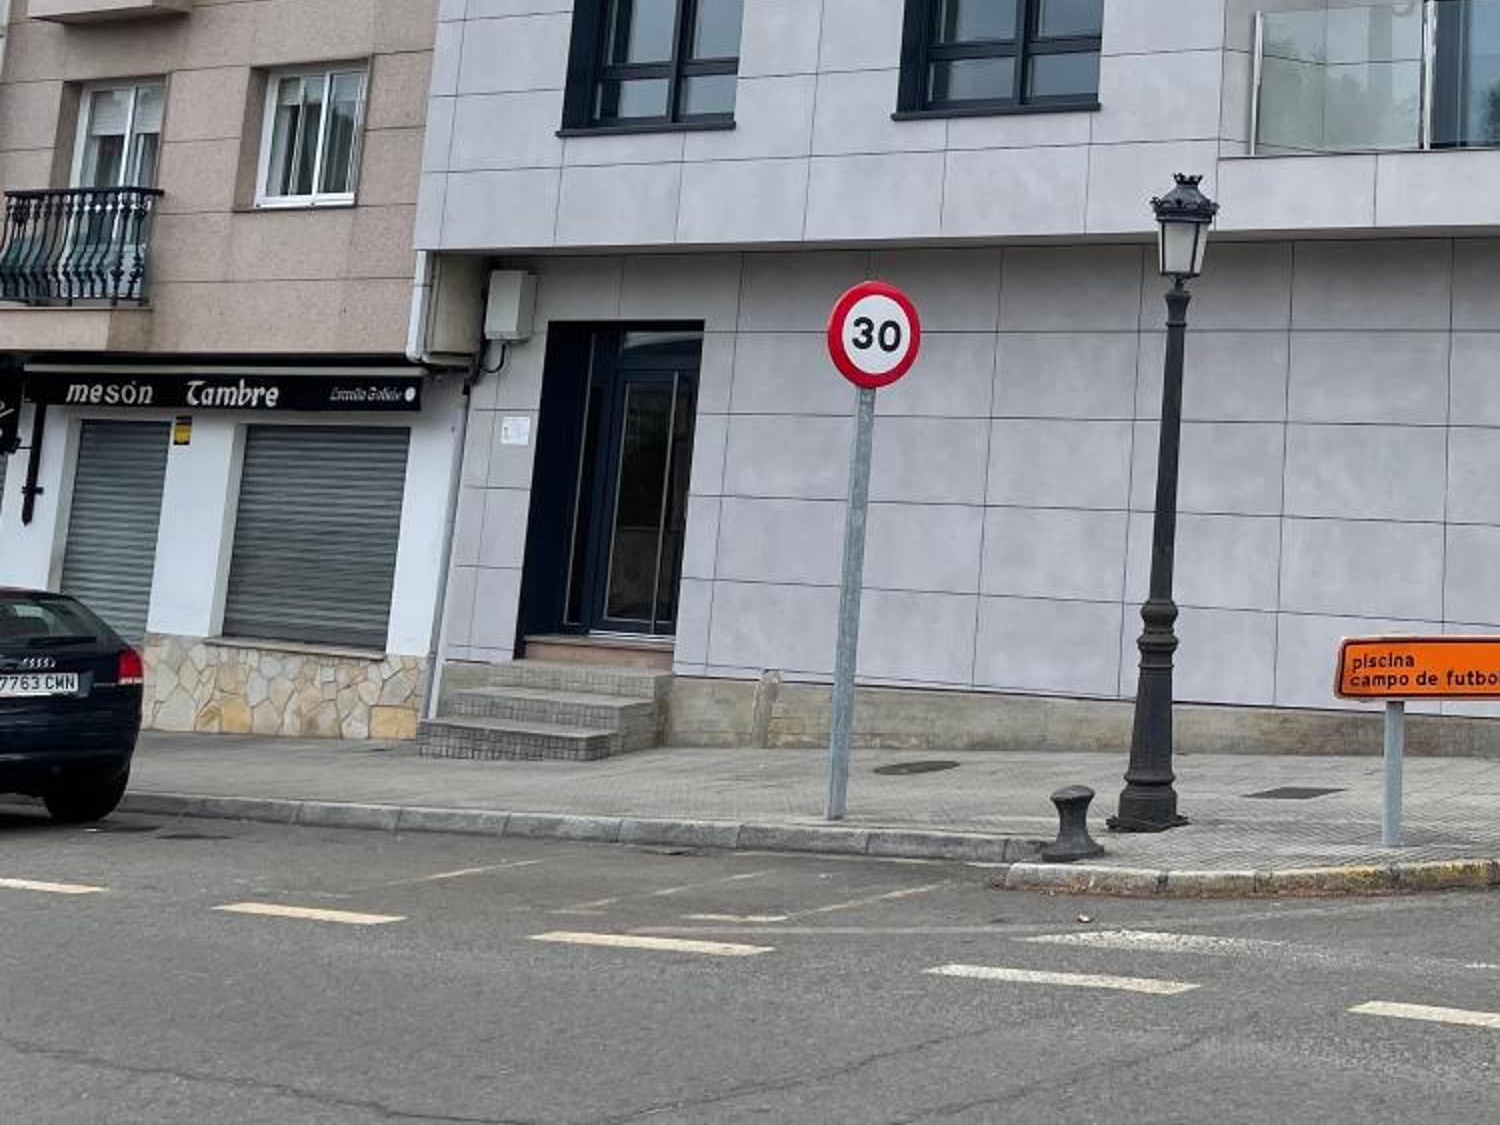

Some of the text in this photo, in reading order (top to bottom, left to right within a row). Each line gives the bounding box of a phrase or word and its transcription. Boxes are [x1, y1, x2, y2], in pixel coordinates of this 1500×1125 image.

[852, 317, 901, 352] 30
[186, 379, 279, 407] Tambre
[1352, 652, 1414, 672] piscina
[1350, 674, 1410, 689] campo
[1415, 671, 1438, 685] de
